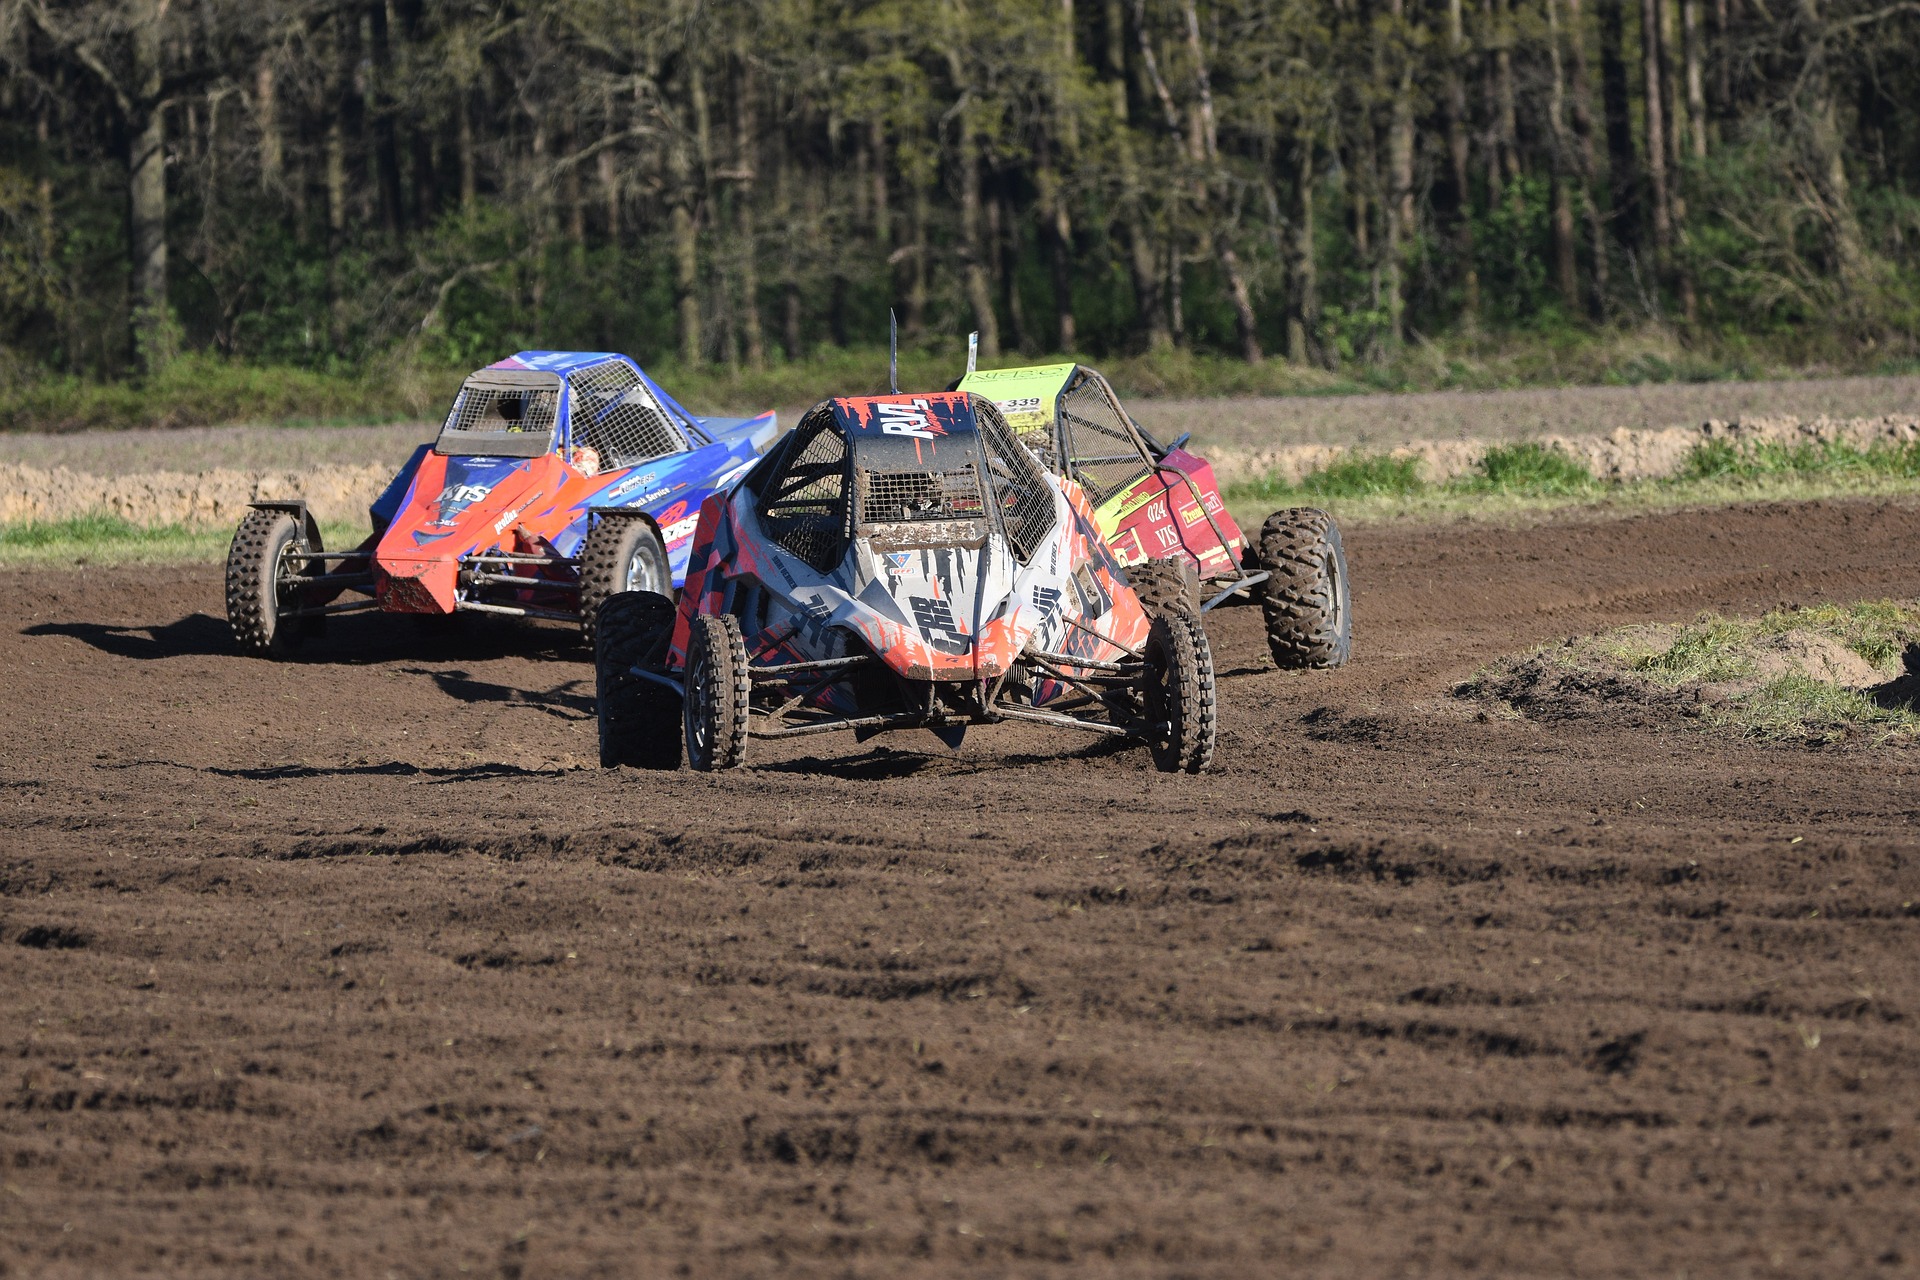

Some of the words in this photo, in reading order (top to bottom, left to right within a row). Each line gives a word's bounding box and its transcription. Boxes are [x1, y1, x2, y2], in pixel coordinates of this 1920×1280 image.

[1008, 398, 1040, 408] 339
[433, 483, 492, 502] KTS
[627, 494, 648, 508] Truck
[645, 487, 671, 502] Service
[1147, 500, 1167, 523] 024
[1155, 525, 1178, 548] VIS
